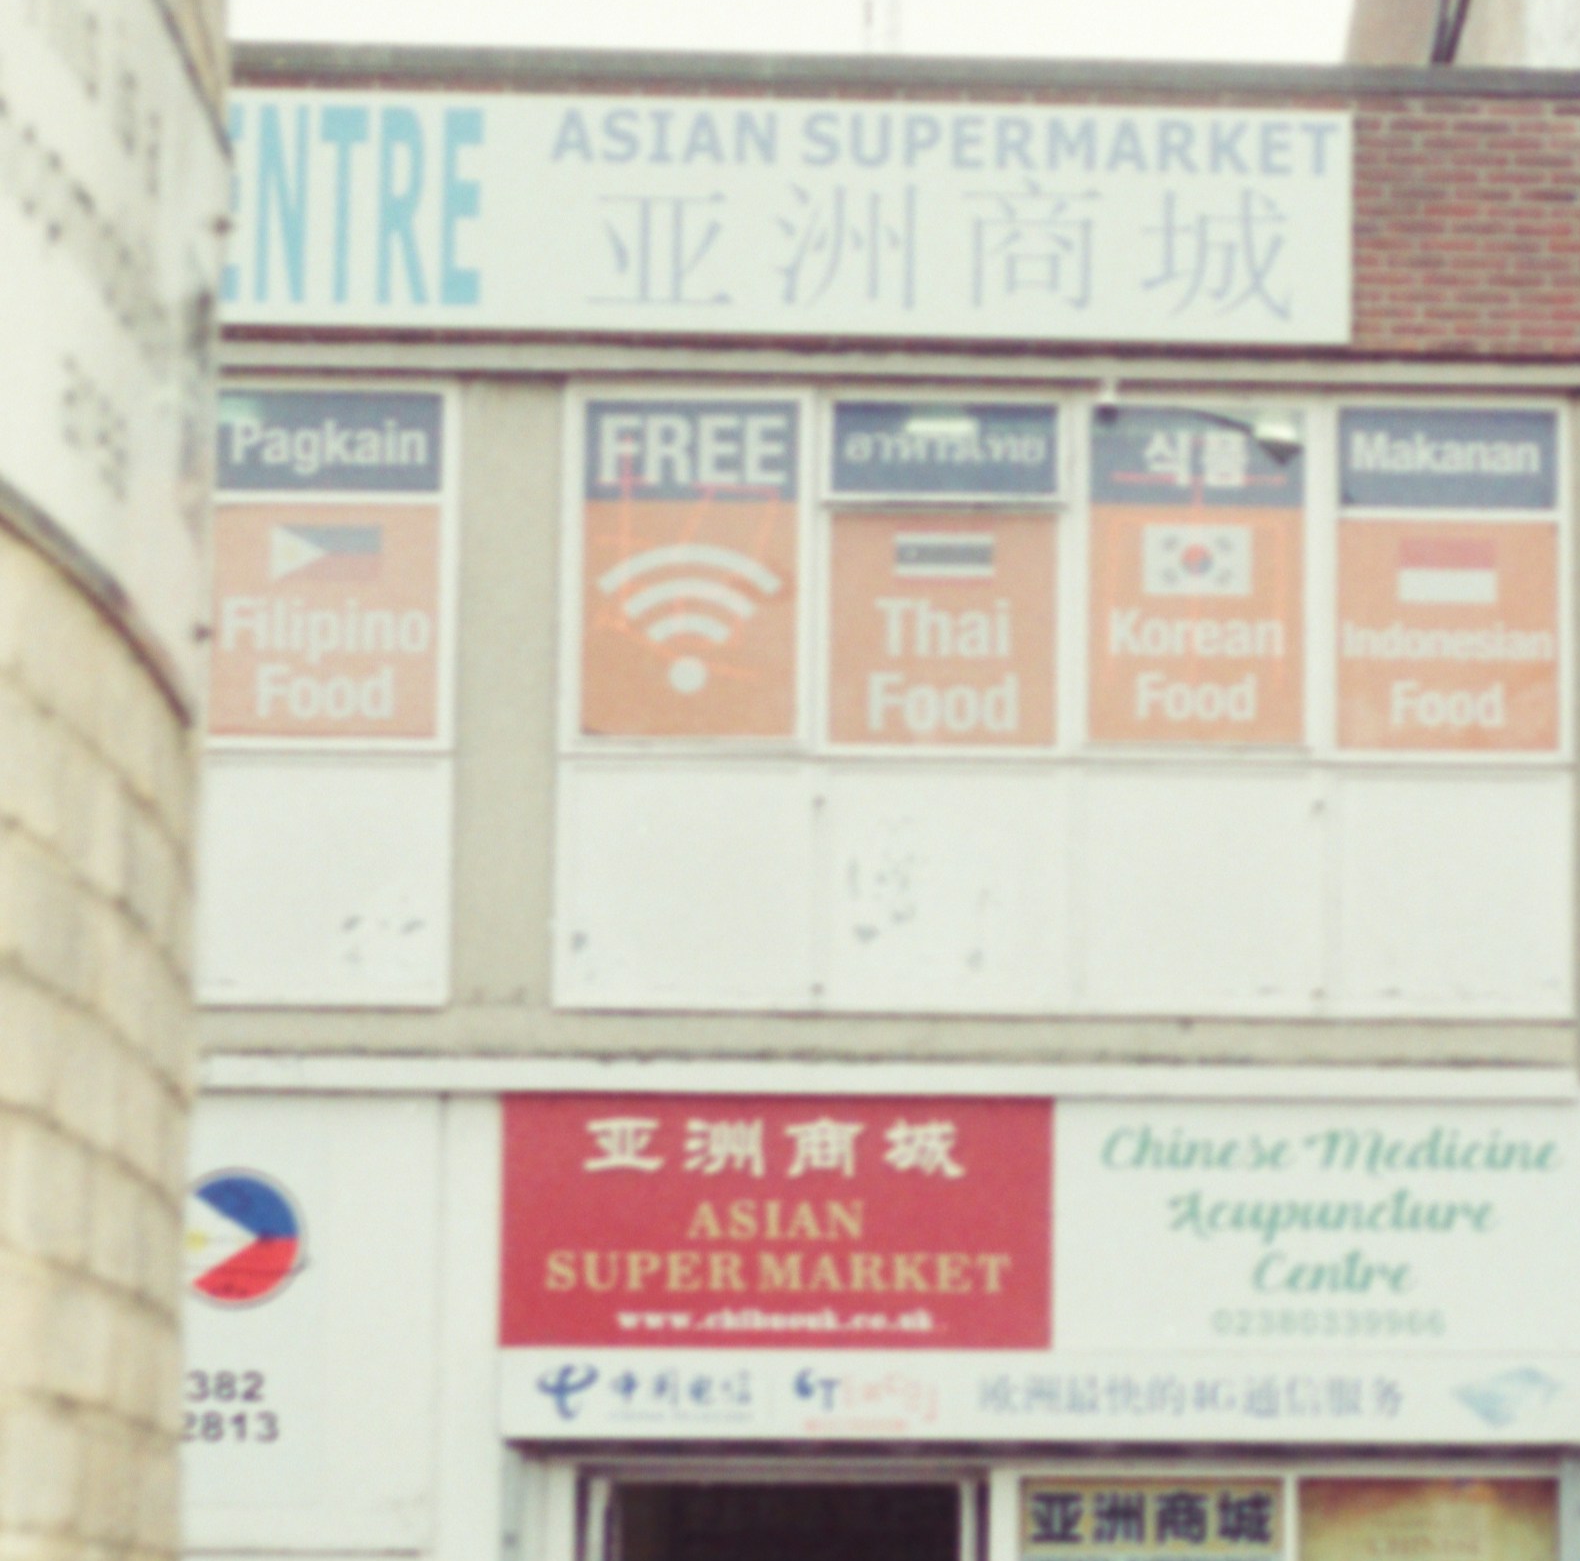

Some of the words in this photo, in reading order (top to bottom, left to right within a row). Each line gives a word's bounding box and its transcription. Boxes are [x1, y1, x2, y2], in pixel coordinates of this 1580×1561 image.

[551, 107, 778, 166] ASIAN
[803, 110, 1338, 178] SUPERMARKET
[588, 178, 1293, 322] 亚洲商城
[230, 418, 427, 475] Pagkain
[599, 412, 787, 485] FREE
[1350, 433, 1540, 474] Makanan
[220, 596, 431, 664] Filipino
[875, 597, 1012, 659] Thai
[1107, 607, 1285, 657] Korean
[1342, 621, 1553, 662] Indonesian
[255, 663, 395, 719] Food
[868, 672, 1019, 732] Food
[1134, 672, 1257, 721] Food
[1388, 680, 1506, 729] Food
[584, 1117, 966, 1178] 亚洲商城
[1100, 1124, 1291, 1172] Chinese
[1303, 1125, 1557, 1176] Medicine
[688, 1199, 864, 1240] ASIAN
[1167, 1189, 1494, 1245] Acupuncture
[1251, 1248, 1411, 1294] Centre
[1031, 1490, 1273, 1544] 亚洲商城
